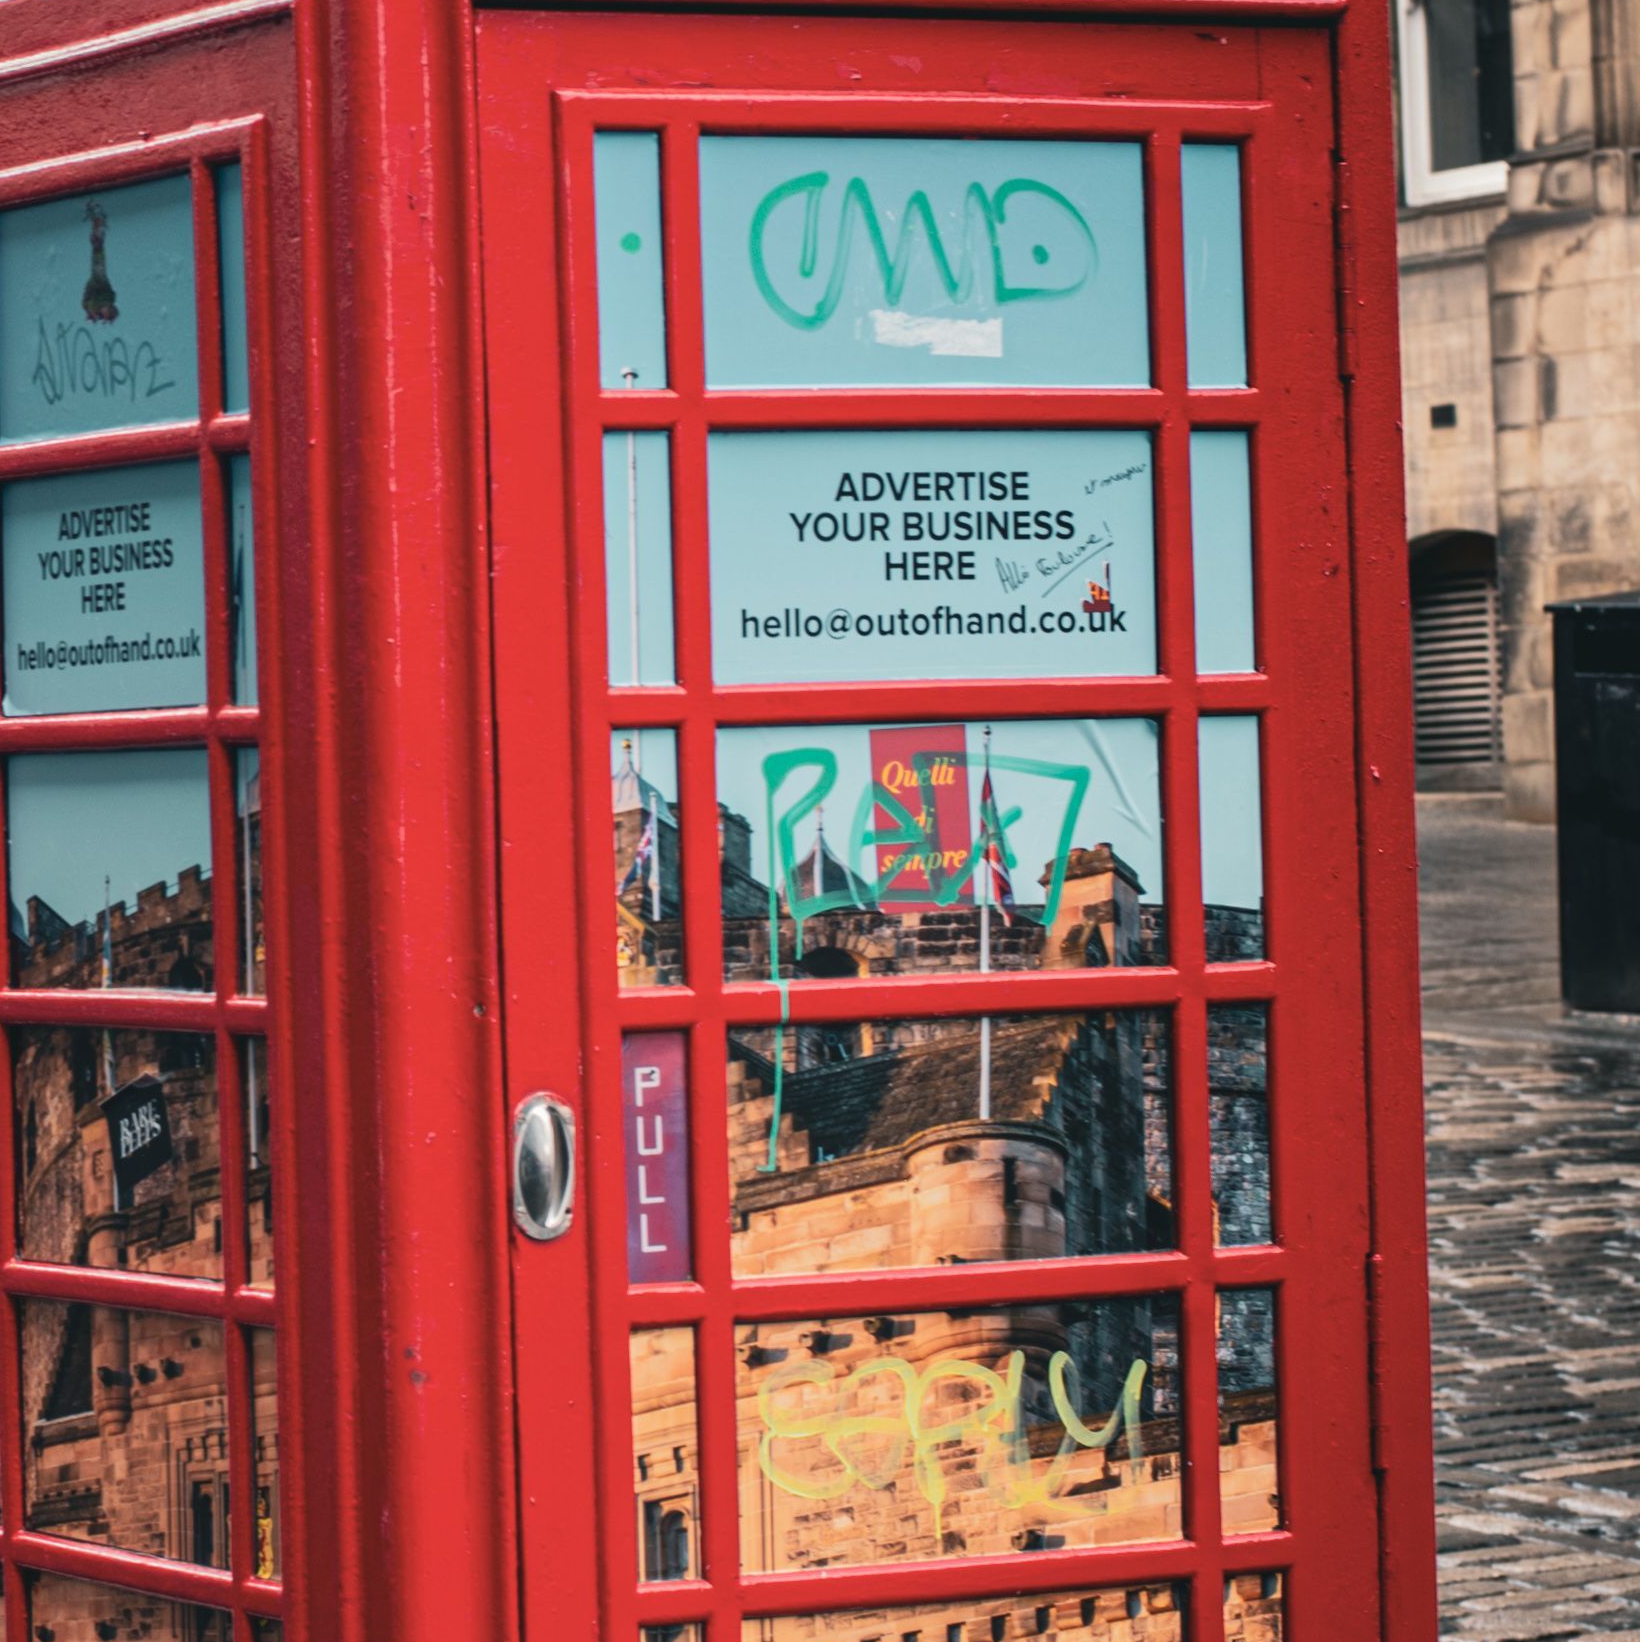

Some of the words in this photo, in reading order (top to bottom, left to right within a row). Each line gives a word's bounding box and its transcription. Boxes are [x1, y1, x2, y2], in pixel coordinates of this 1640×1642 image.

[834, 472, 1029, 502] ADVERTISE
[58, 502, 151, 541] ADVERTISE
[789, 513, 889, 543] YOUR
[903, 510, 1075, 541] BUSINESS
[38, 548, 85, 580] YOUR
[89, 538, 174, 575] BUSINESS
[885, 551, 976, 581] HERE
[81, 582, 126, 614] HERE
[740, 603, 1128, 640] hello@outofhand.co.uk
[17, 628, 201, 670] hello@outofhand.co.uk
[881, 757, 956, 794] Quelli
[914, 805, 936, 835] di
[881, 850, 968, 881] sempre
[634, 1066, 667, 1253] PULL
